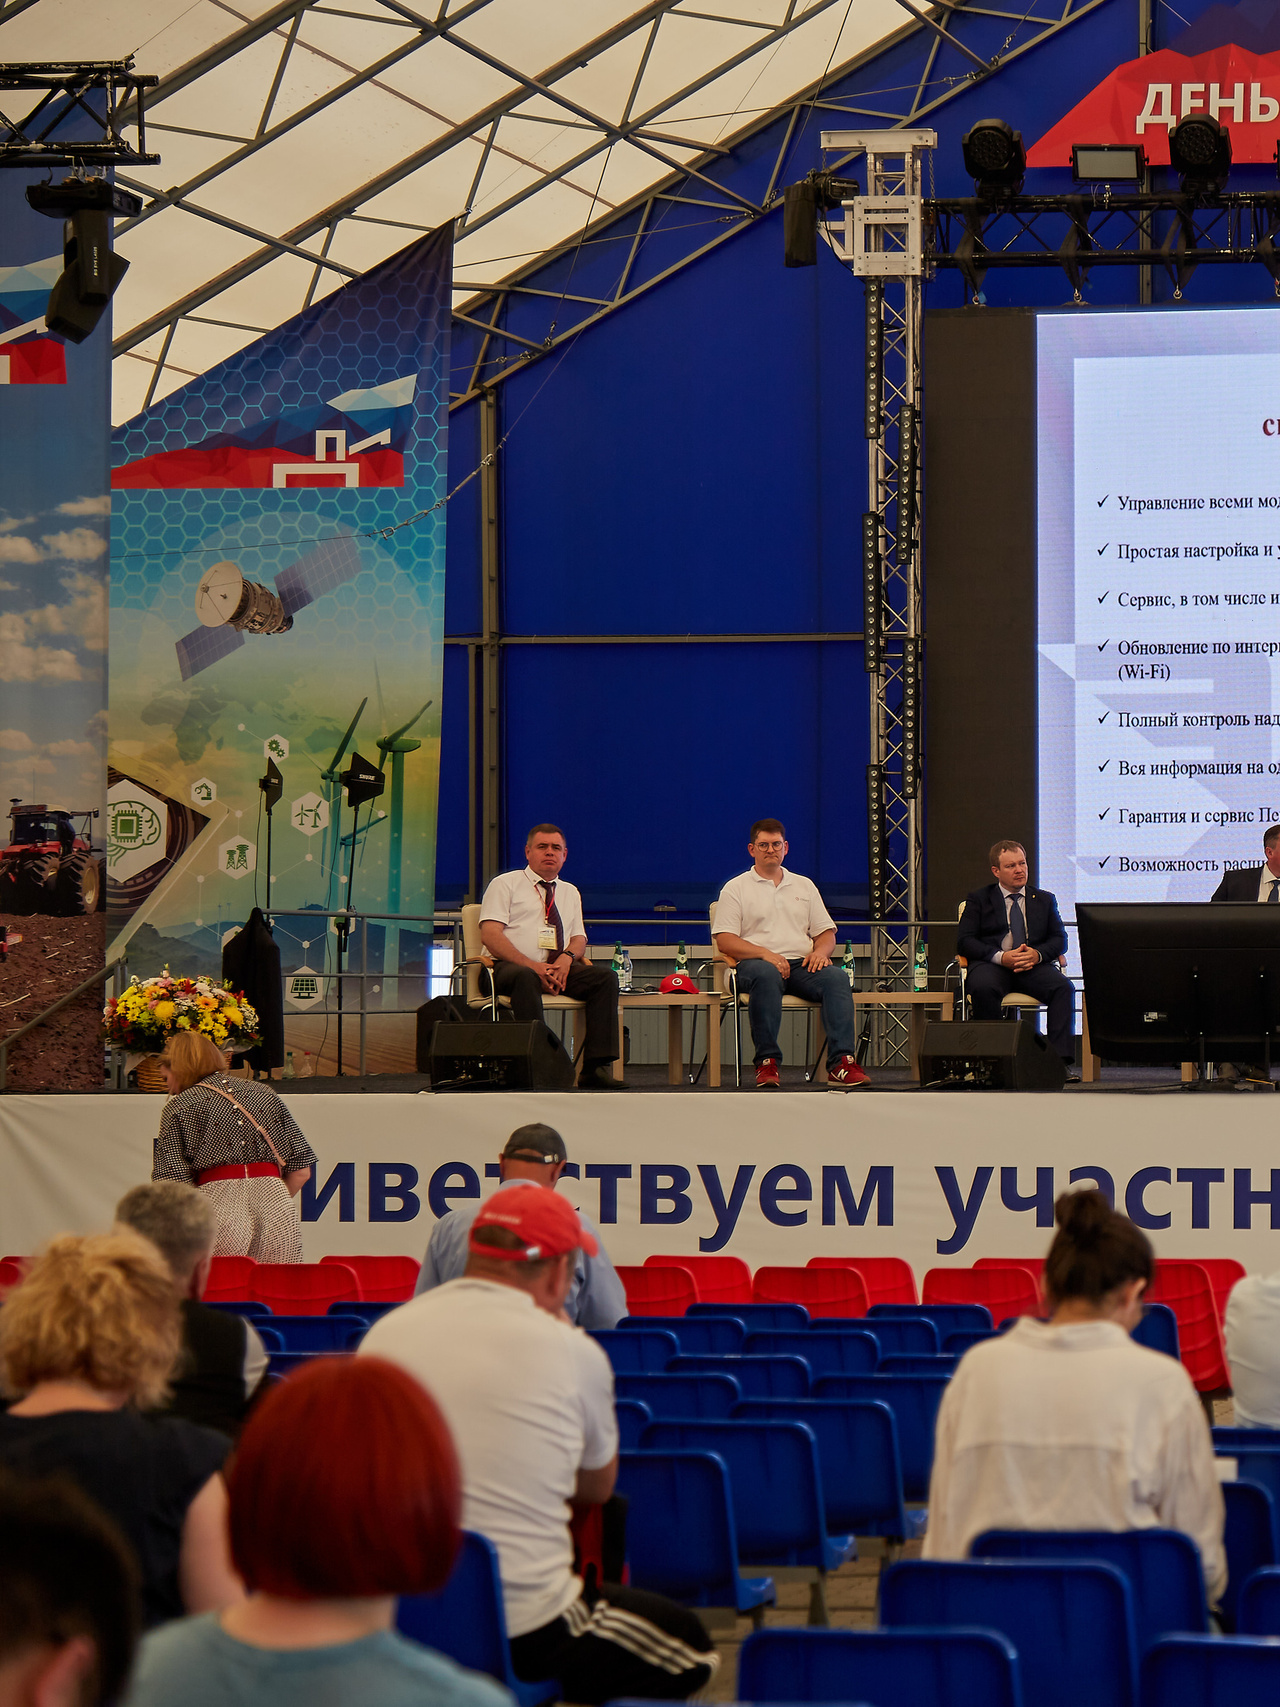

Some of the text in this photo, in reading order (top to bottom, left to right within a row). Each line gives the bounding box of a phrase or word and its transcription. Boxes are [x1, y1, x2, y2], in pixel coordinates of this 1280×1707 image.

[1136, 82, 1280, 134] ДЕНЬ
[1117, 495, 1205, 515] Управление
[1209, 497, 1253, 509] всеми
[1118, 543, 1180, 563] Простая
[1183, 542, 1259, 562] настройка
[1263, 545, 1273, 557] и
[1117, 592, 1176, 611] Сервис,
[1180, 595, 1189, 606] в
[1192, 594, 1219, 606] том
[1224, 593, 1266, 606] числе
[1270, 593, 1280, 605] и
[1117, 640, 1209, 656] Обновление
[1212, 642, 1231, 654] по
[1118, 663, 1171, 682] (Wi-Fi)
[1118, 711, 1179, 728] Полный
[1182, 714, 1251, 731] контроль
[1253, 714, 1280, 727] над
[1118, 760, 1146, 776] Вся
[1150, 759, 1243, 779] информация
[1246, 762, 1264, 775] на
[1119, 808, 1187, 828] Гарантия
[1191, 812, 1200, 823] и
[1204, 811, 1255, 827] сервис
[1118, 856, 1219, 872] Возможность
